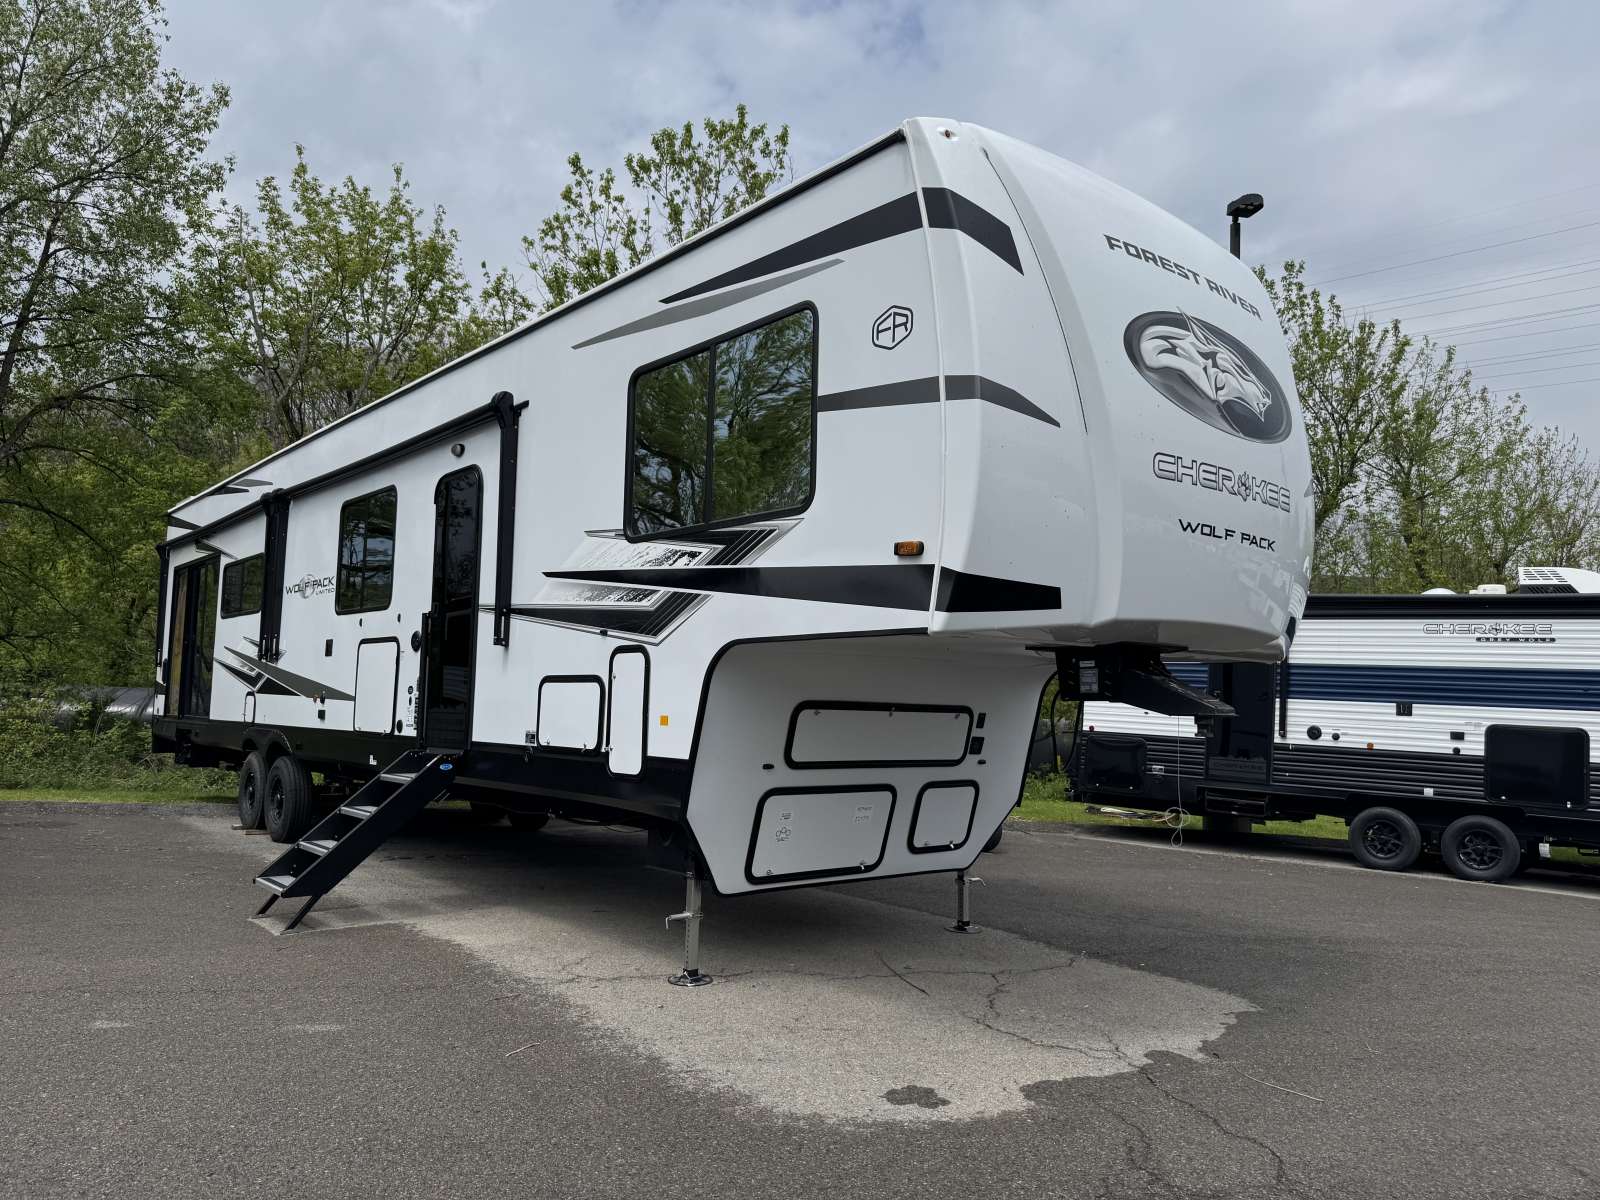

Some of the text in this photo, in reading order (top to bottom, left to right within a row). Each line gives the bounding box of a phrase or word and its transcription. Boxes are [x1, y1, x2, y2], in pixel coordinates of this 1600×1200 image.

[1103, 233, 1263, 321] FOREST RIVER
[1178, 518, 1276, 552] WOLF PACK
[285, 576, 335, 595] WOLF PACK
